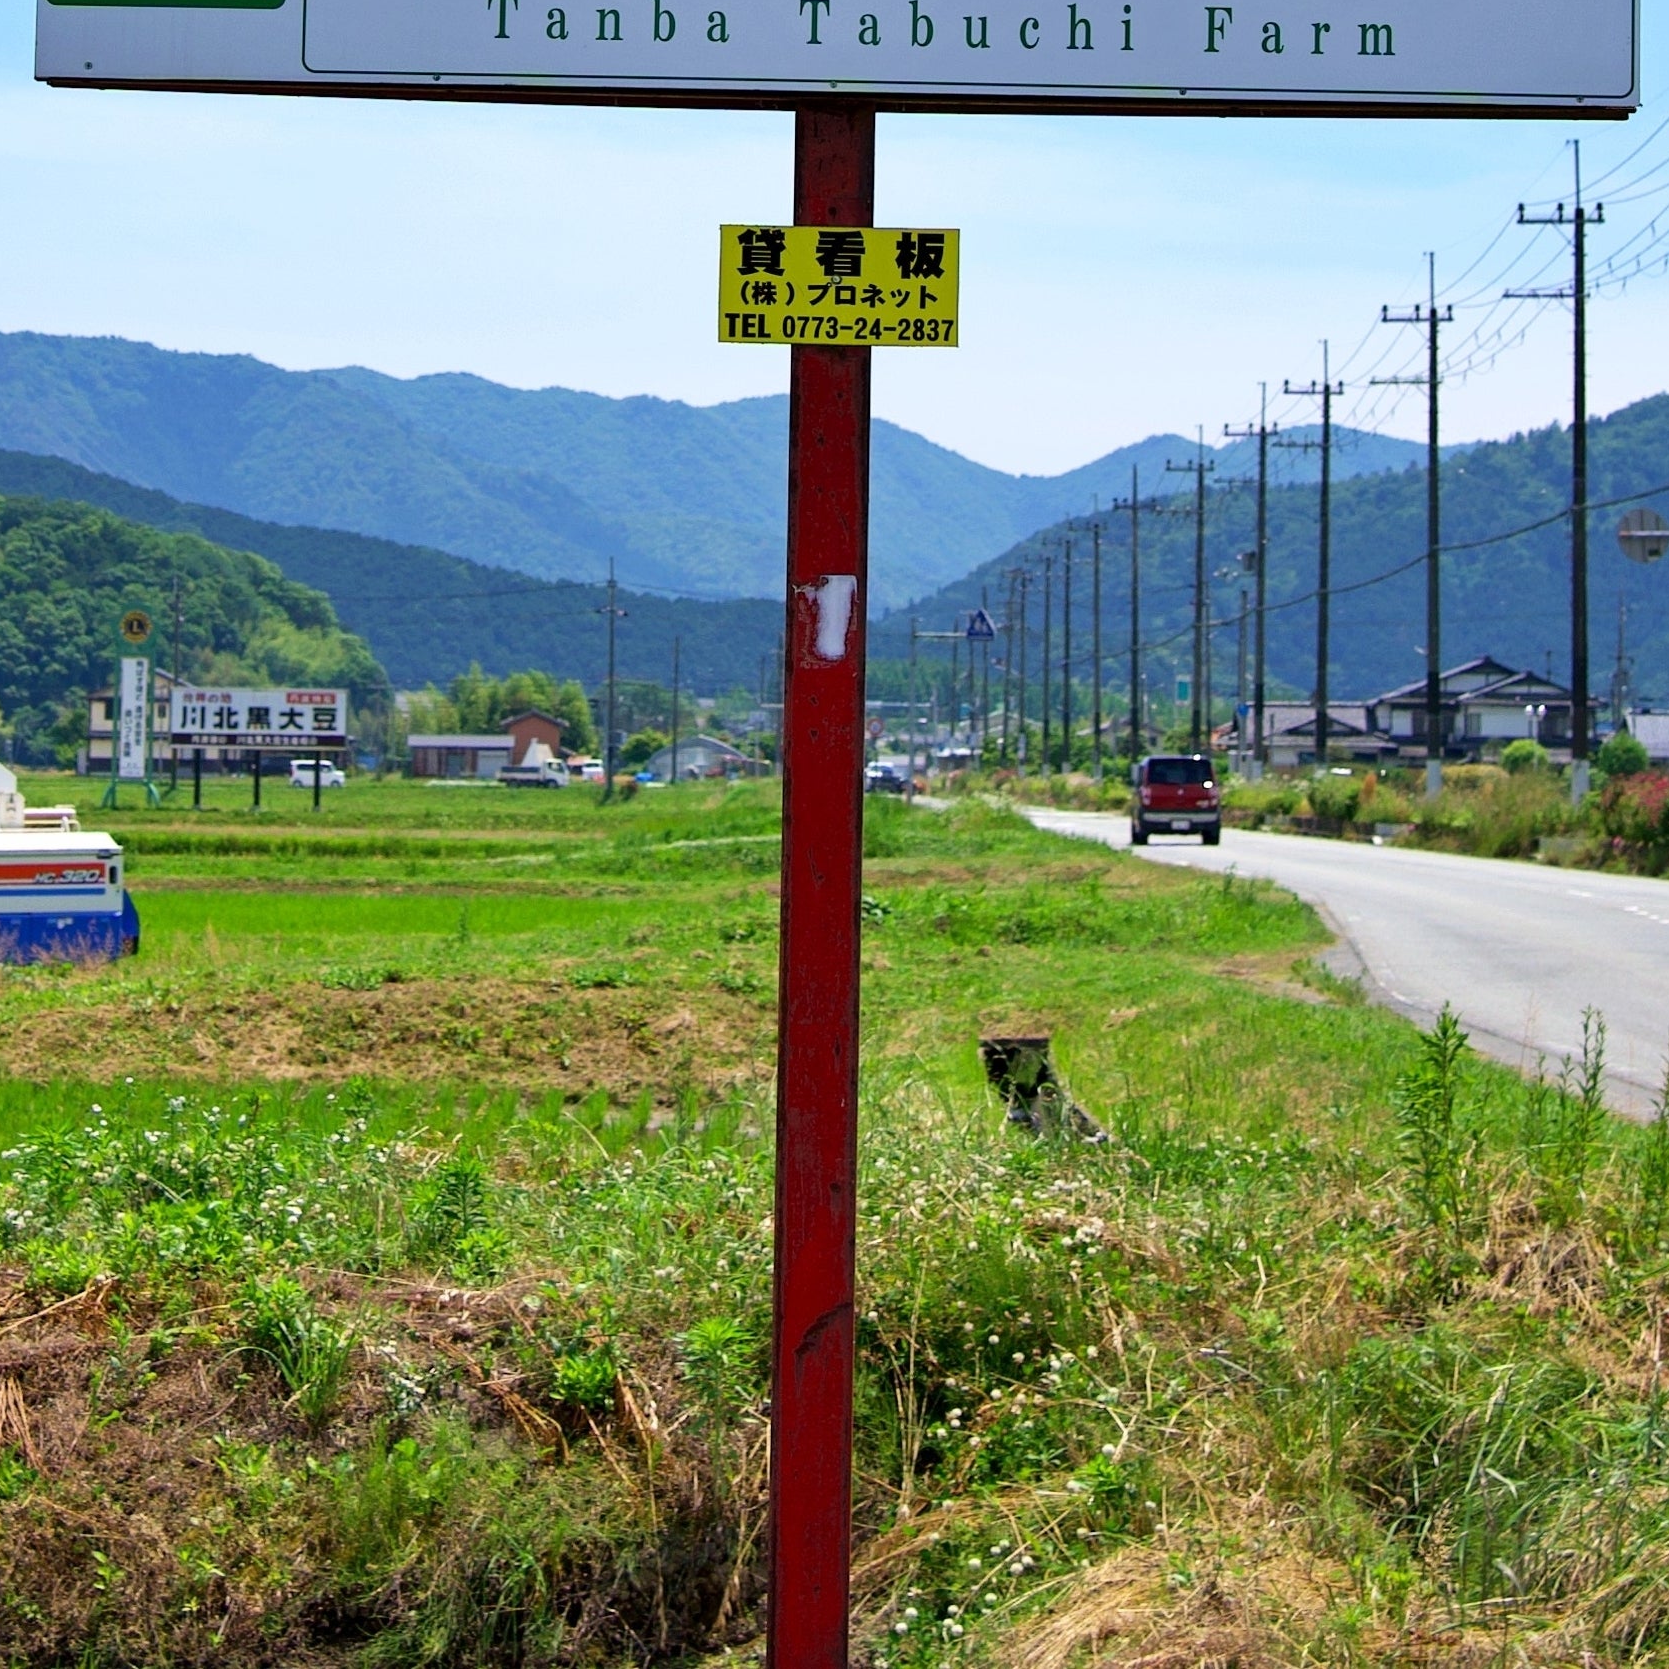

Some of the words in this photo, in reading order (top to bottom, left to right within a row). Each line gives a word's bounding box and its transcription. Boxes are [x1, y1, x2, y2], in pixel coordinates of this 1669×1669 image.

[799, 0, 1137, 53] Tabuchi
[1204, 6, 1398, 57] Farm
[737, 229, 945, 279] 貸看板
[725, 313, 771, 338] TEL
[783, 316, 954, 342] 0773-24-2837
[181, 706, 337, 731] 川北黒大豆
[57, 869, 100, 884] 320
